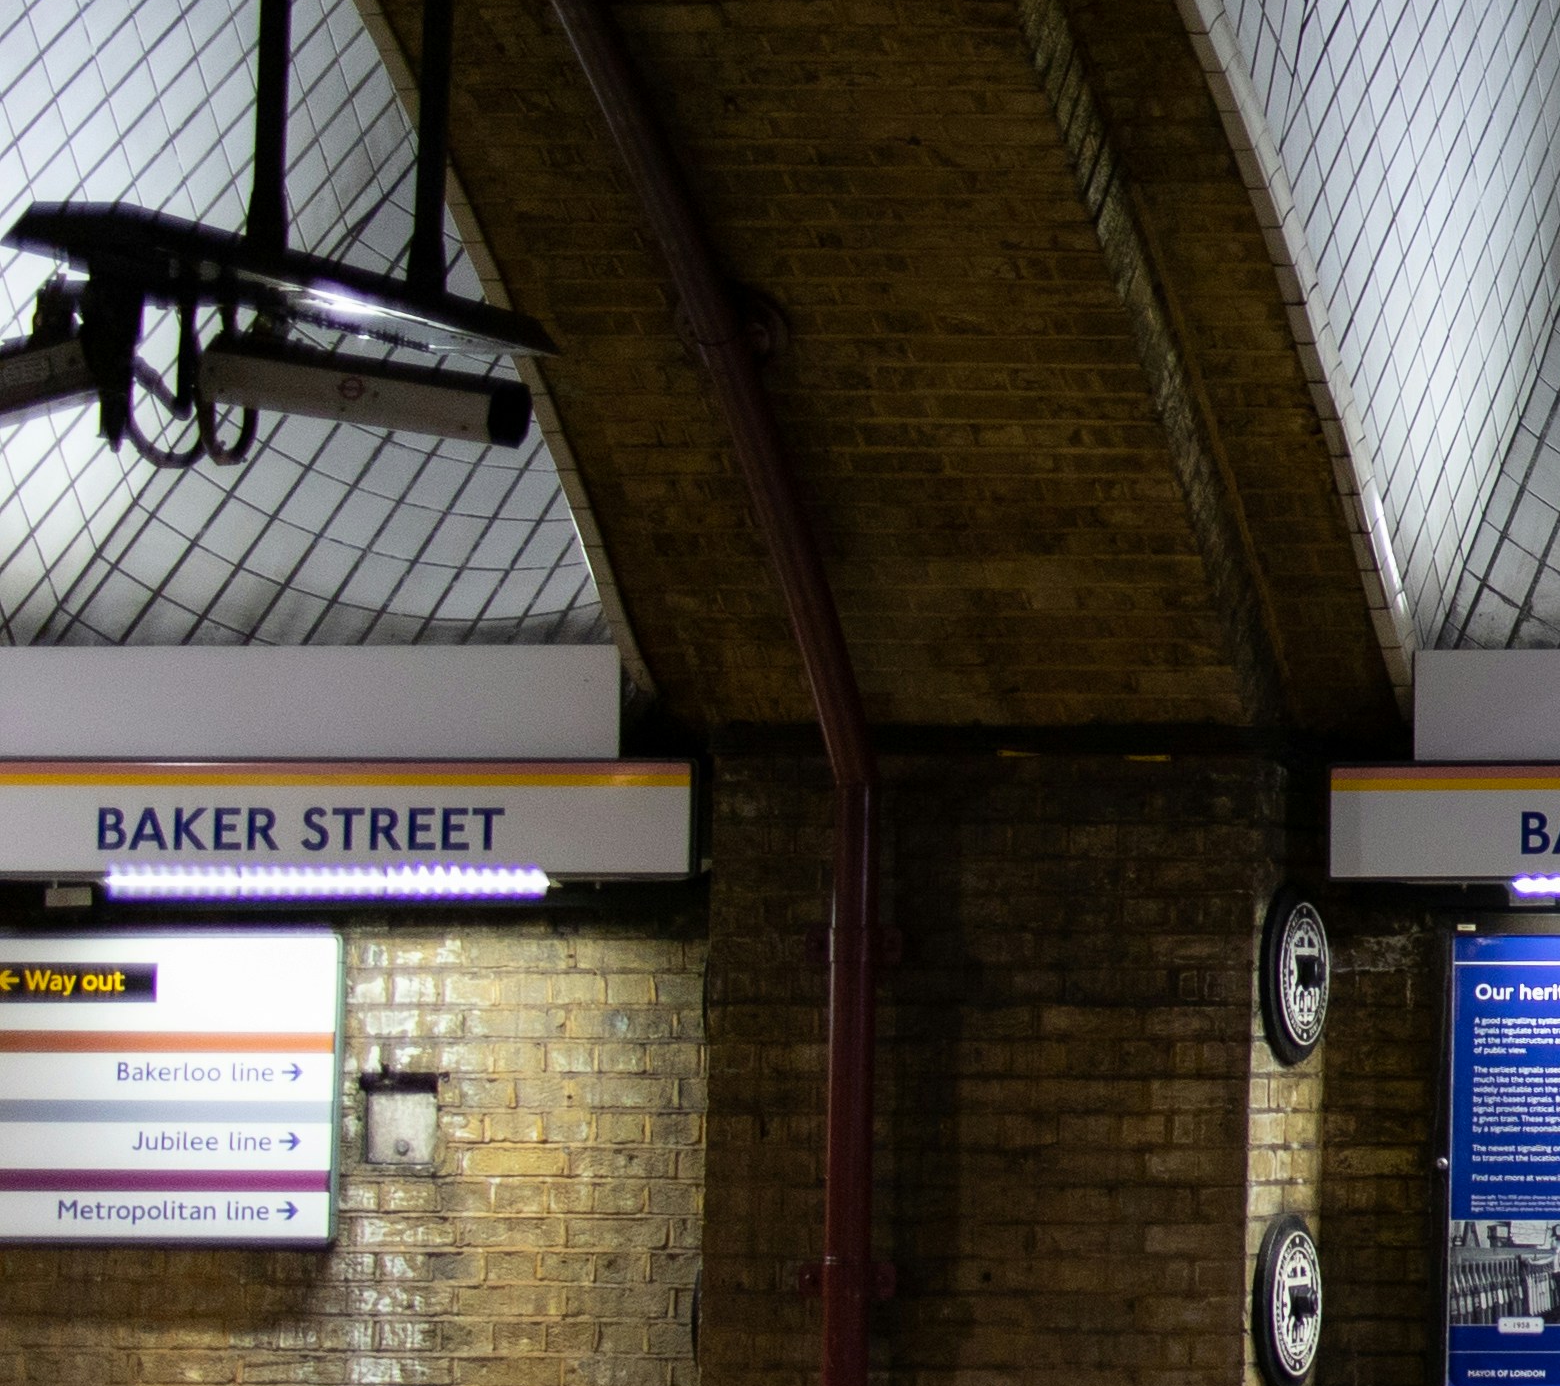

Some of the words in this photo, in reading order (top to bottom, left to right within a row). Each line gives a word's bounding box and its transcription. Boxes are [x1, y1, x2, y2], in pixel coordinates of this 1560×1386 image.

[98, 807, 279, 850] BAKER
[302, 807, 505, 851] STREET
[25, 969, 76, 996] Way
[82, 971, 125, 992] out
[1475, 984, 1514, 1000] Our
[117, 1062, 220, 1081] Bakerloo
[233, 1064, 273, 1081] line
[132, 1131, 218, 1150] Jubilee
[230, 1132, 271, 1151] line
[58, 1200, 216, 1225] Metropolitan
[227, 1201, 269, 1220] line
